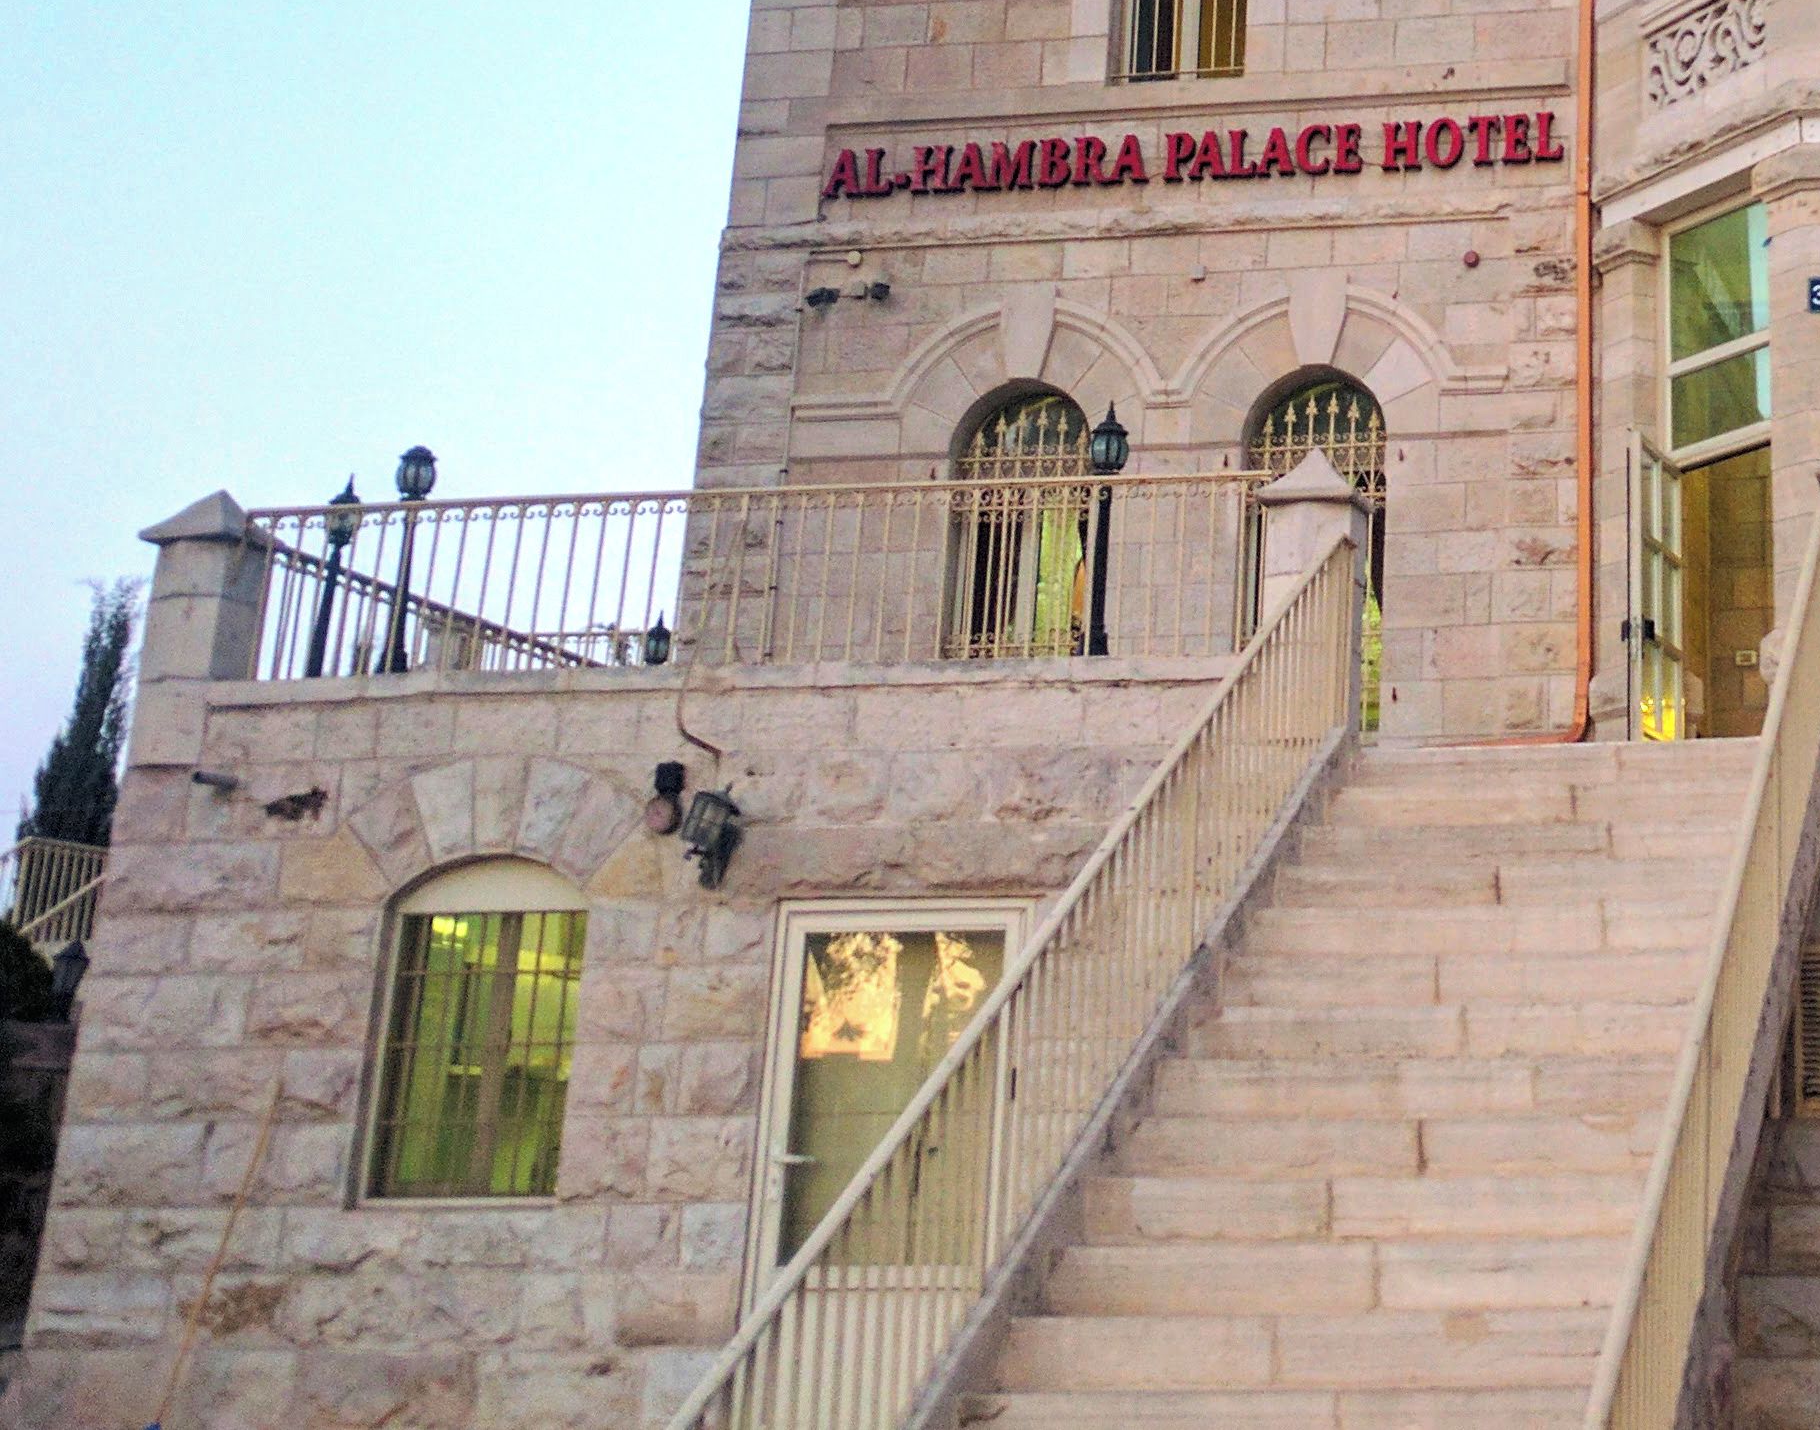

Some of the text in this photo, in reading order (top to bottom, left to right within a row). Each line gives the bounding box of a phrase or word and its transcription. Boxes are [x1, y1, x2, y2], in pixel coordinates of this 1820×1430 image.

[821, 112, 1565, 199] AL-HAMBRA PALACE HOTEL
